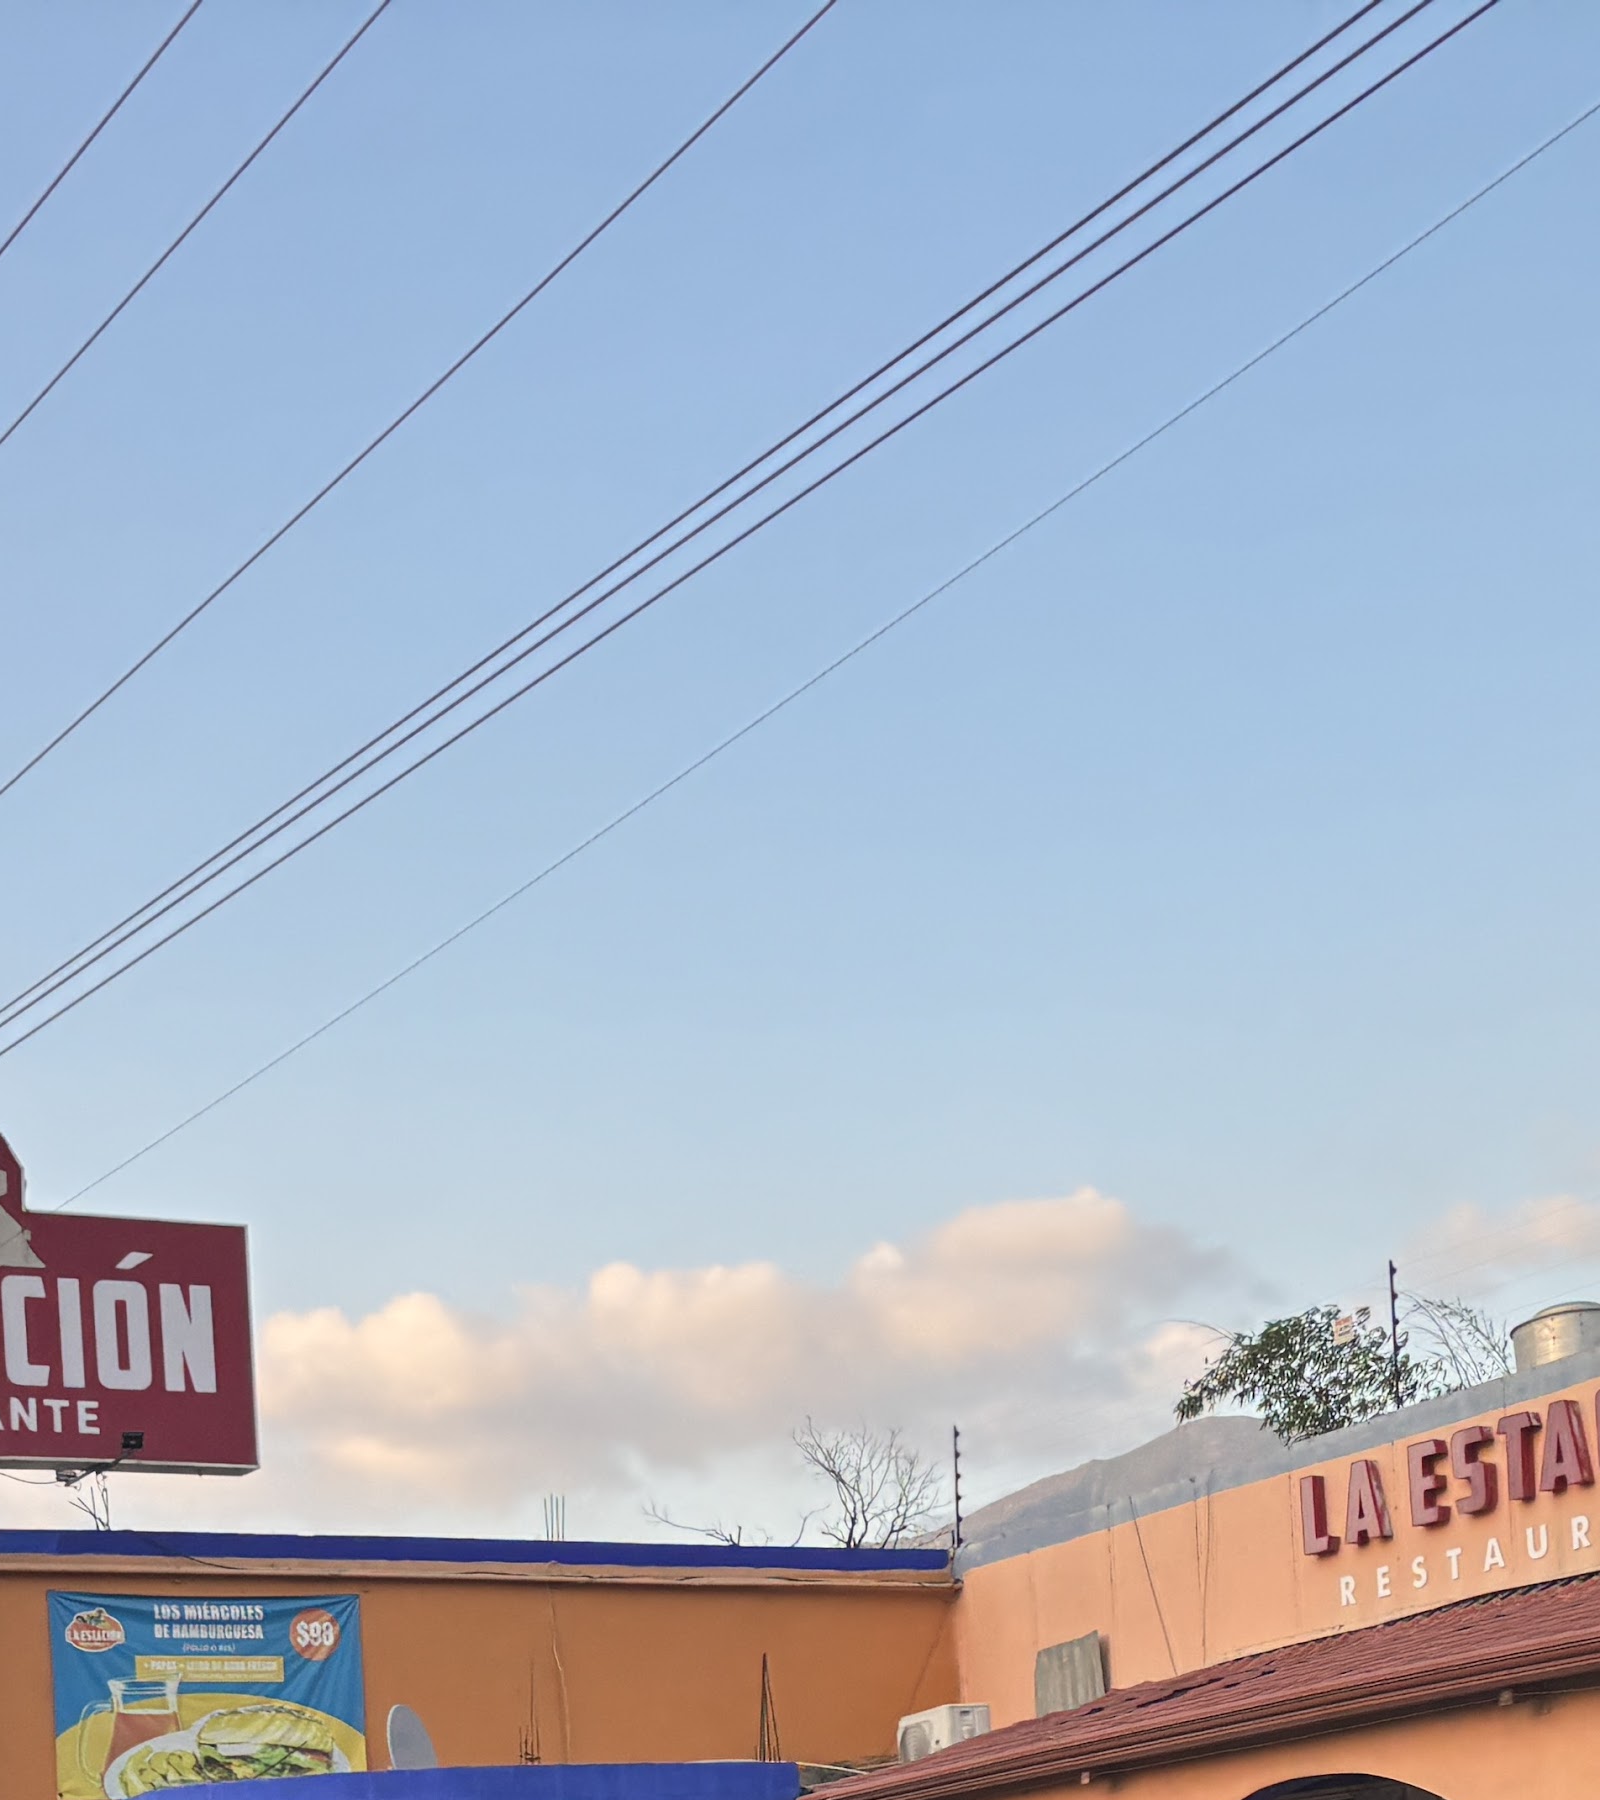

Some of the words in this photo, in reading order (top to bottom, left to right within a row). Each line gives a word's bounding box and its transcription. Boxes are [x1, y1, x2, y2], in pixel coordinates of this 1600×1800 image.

[1300, 1459, 1393, 1556] LA
[153, 1603, 180, 1620] LOS
[154, 1624, 170, 1639] DE
[172, 1624, 264, 1639] HAMBURGUESA
